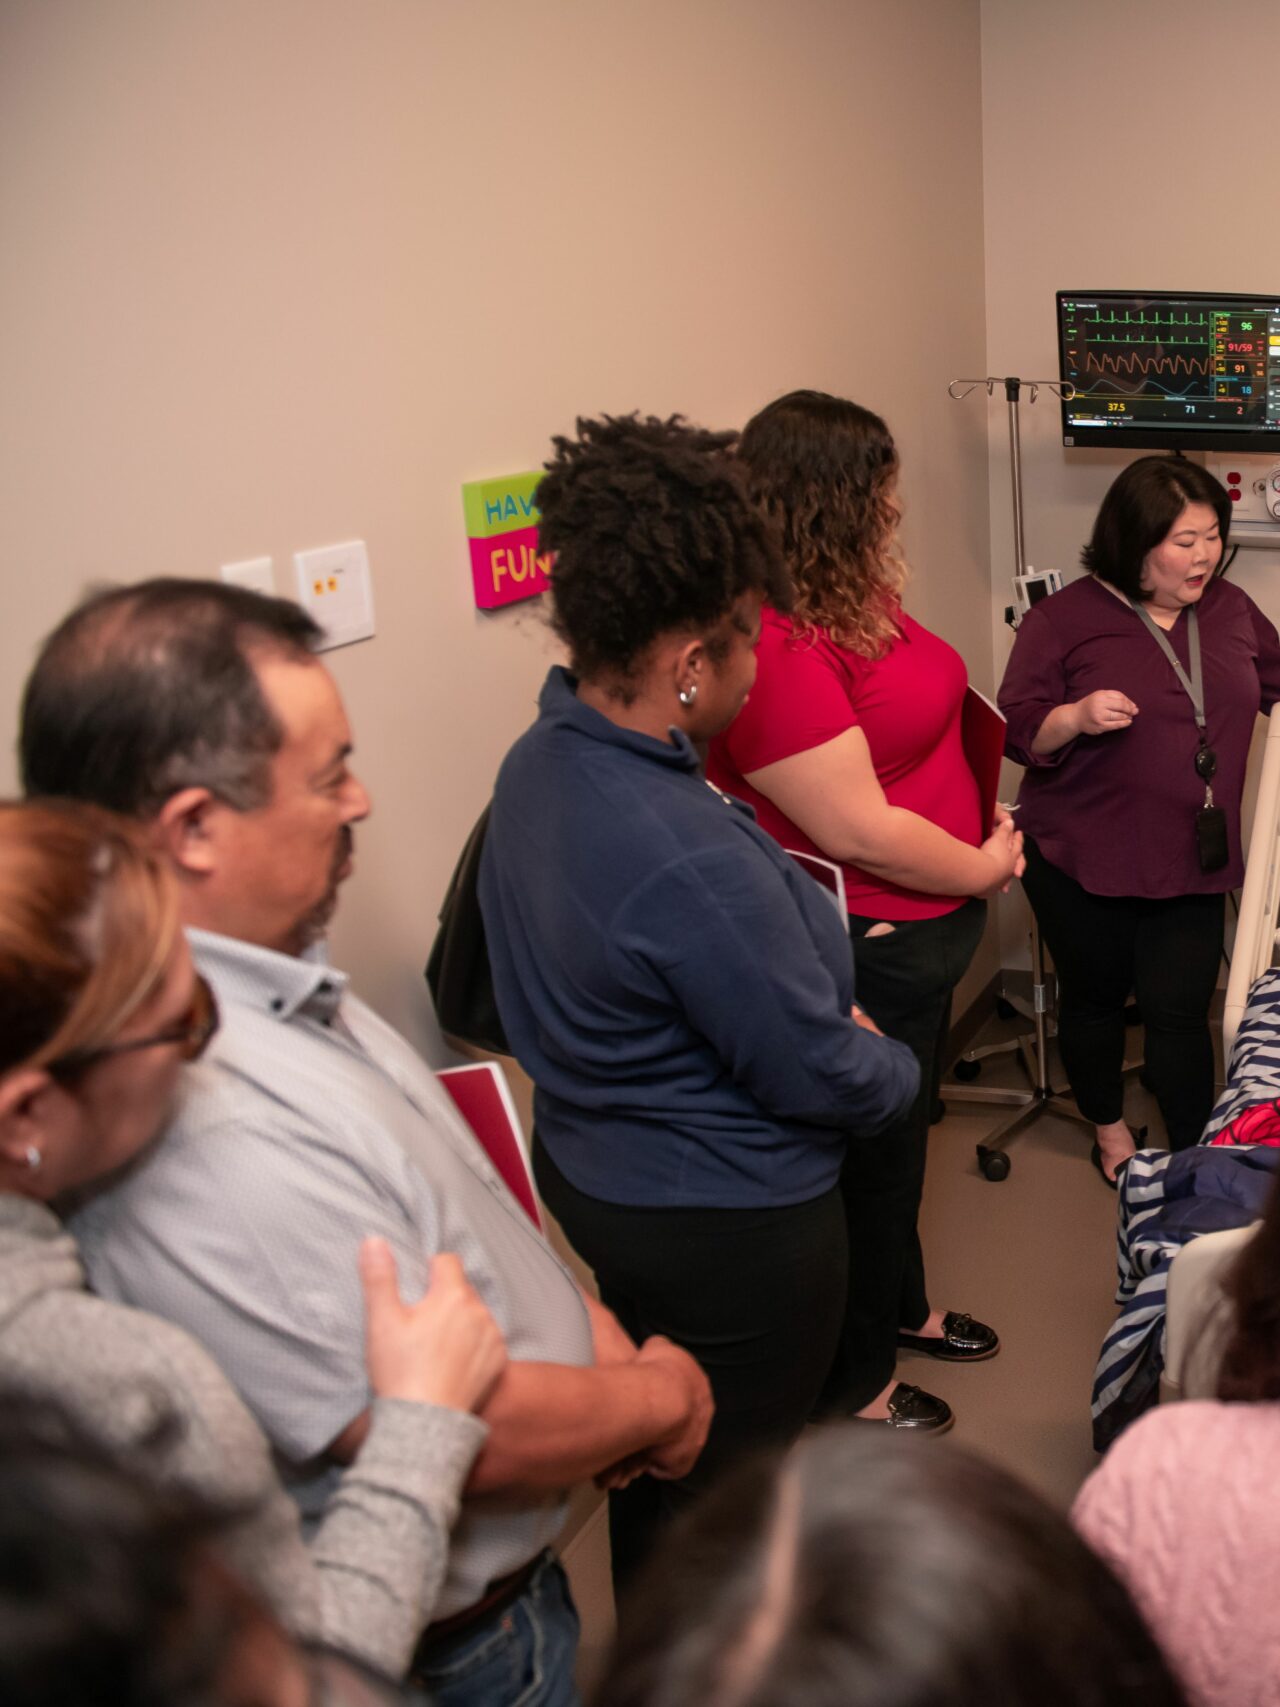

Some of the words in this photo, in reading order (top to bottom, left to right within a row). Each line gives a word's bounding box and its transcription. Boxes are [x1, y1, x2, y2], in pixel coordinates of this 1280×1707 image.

[1241, 322, 1253, 331] 96
[1228, 343, 1253, 352] 91/59
[1234, 364, 1245, 373] 91
[1241, 386, 1252, 394] 18
[1108, 403, 1126, 412] 37.5
[1185, 405, 1196, 414] 71
[1236, 406, 1244, 415] 2
[485, 489, 542, 524] HAV
